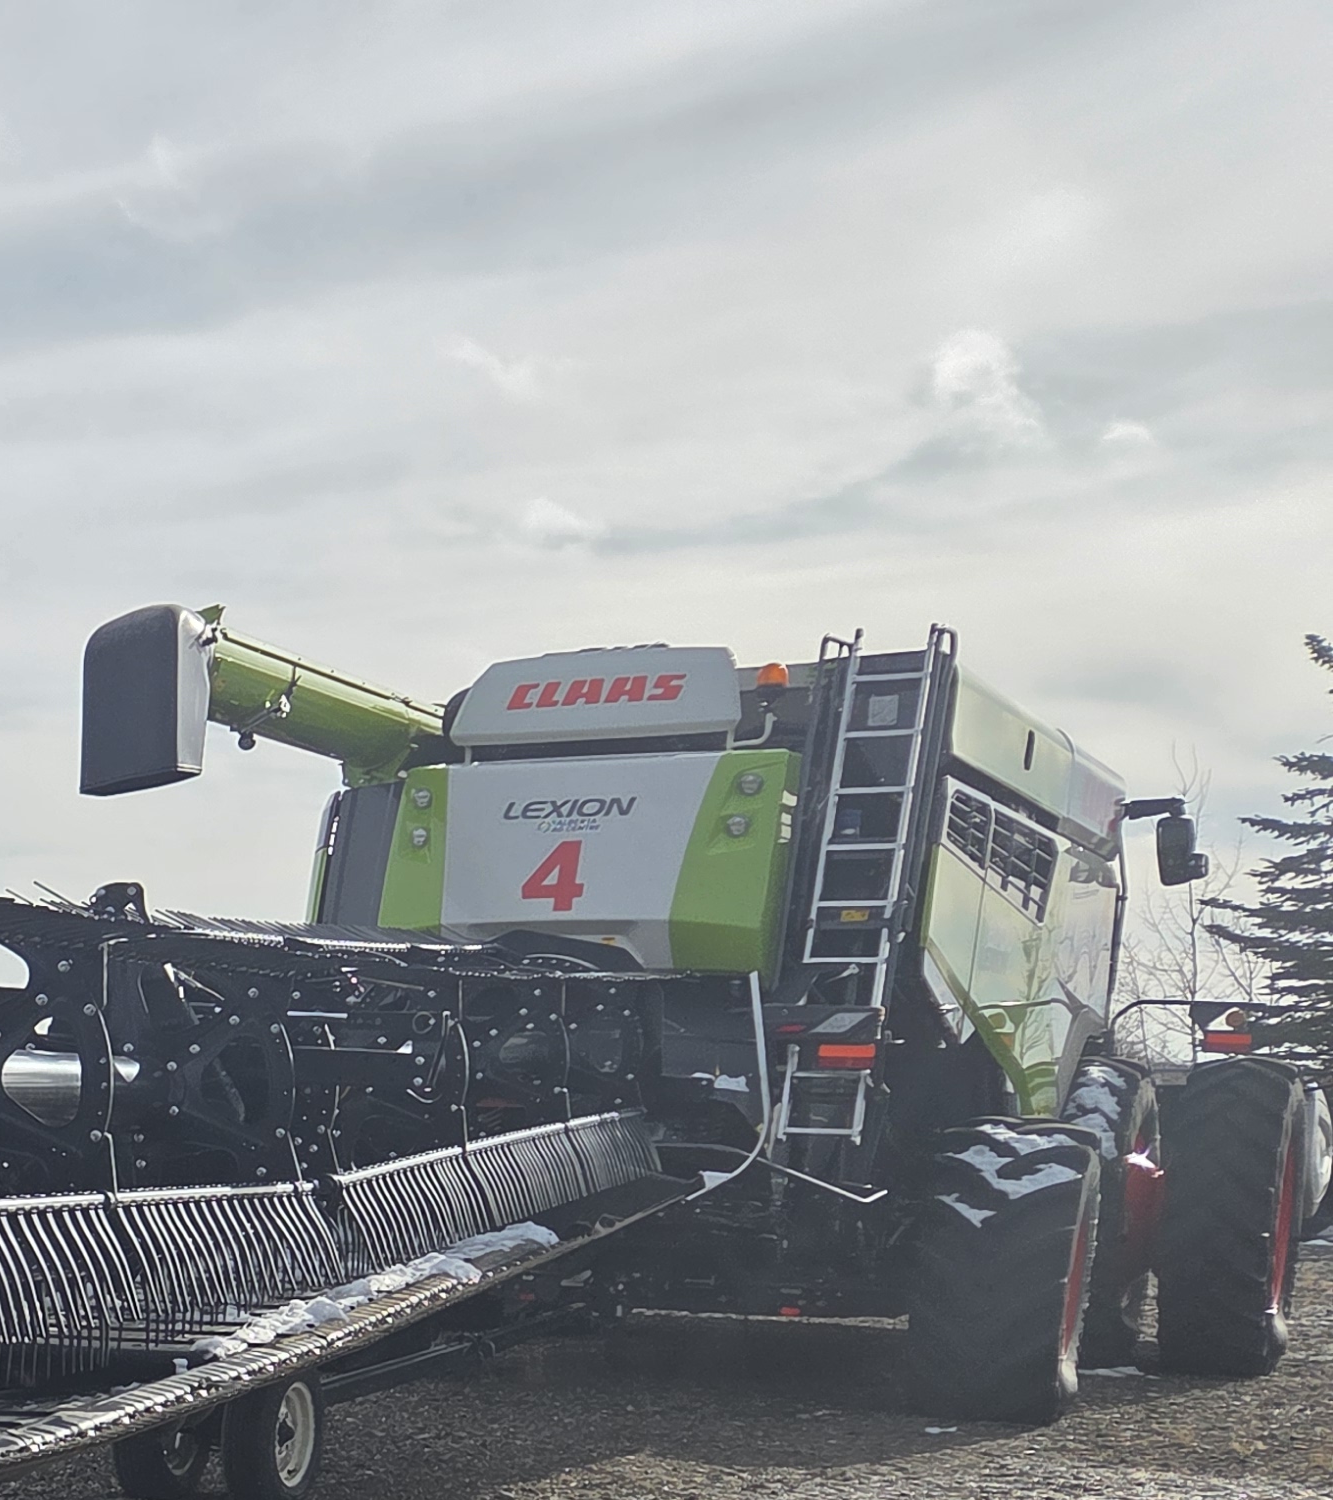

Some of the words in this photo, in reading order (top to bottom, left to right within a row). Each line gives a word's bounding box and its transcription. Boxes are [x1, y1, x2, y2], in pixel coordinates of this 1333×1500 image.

[506, 673, 687, 711] CLAAS
[503, 796, 638, 820] LEXION
[521, 840, 585, 912] 4
